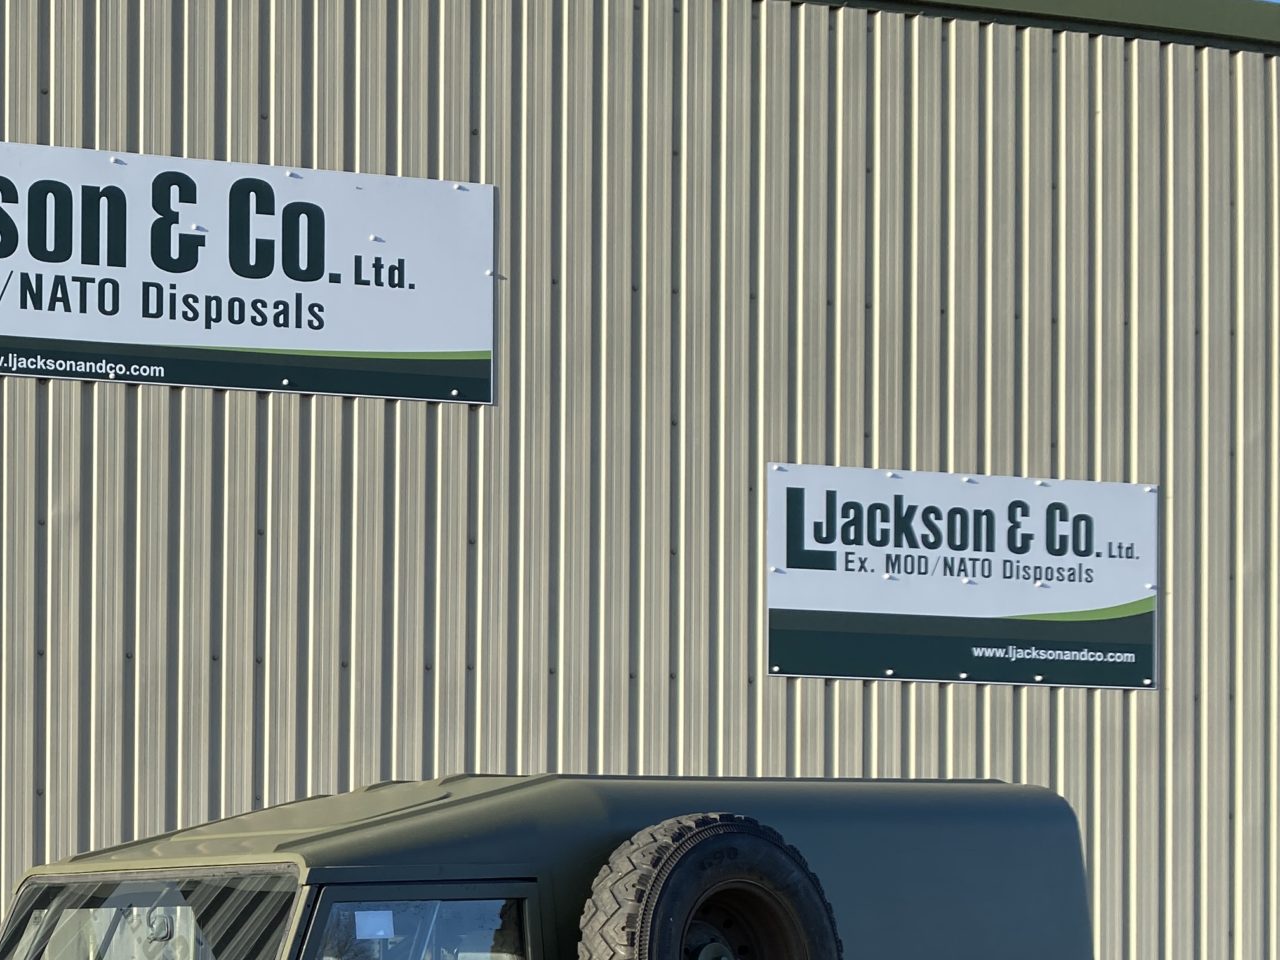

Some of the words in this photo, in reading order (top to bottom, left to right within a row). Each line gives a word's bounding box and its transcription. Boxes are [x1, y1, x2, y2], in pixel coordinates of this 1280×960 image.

[151, 171, 206, 274] &
[229, 178, 342, 284] Co.
[355, 255, 417, 290] Ltd.
[142, 282, 325, 330] Disposals
[1007, 500, 1035, 555] &
[1046, 502, 1102, 558] Co.
[1108, 542, 1140, 560] Ltd.
[845, 552, 875, 573] Ex.
[886, 554, 993, 579] MOD/NATO
[1003, 560, 1094, 584] Disposals
[972, 646, 1136, 663] www.ljacksonandco.com
